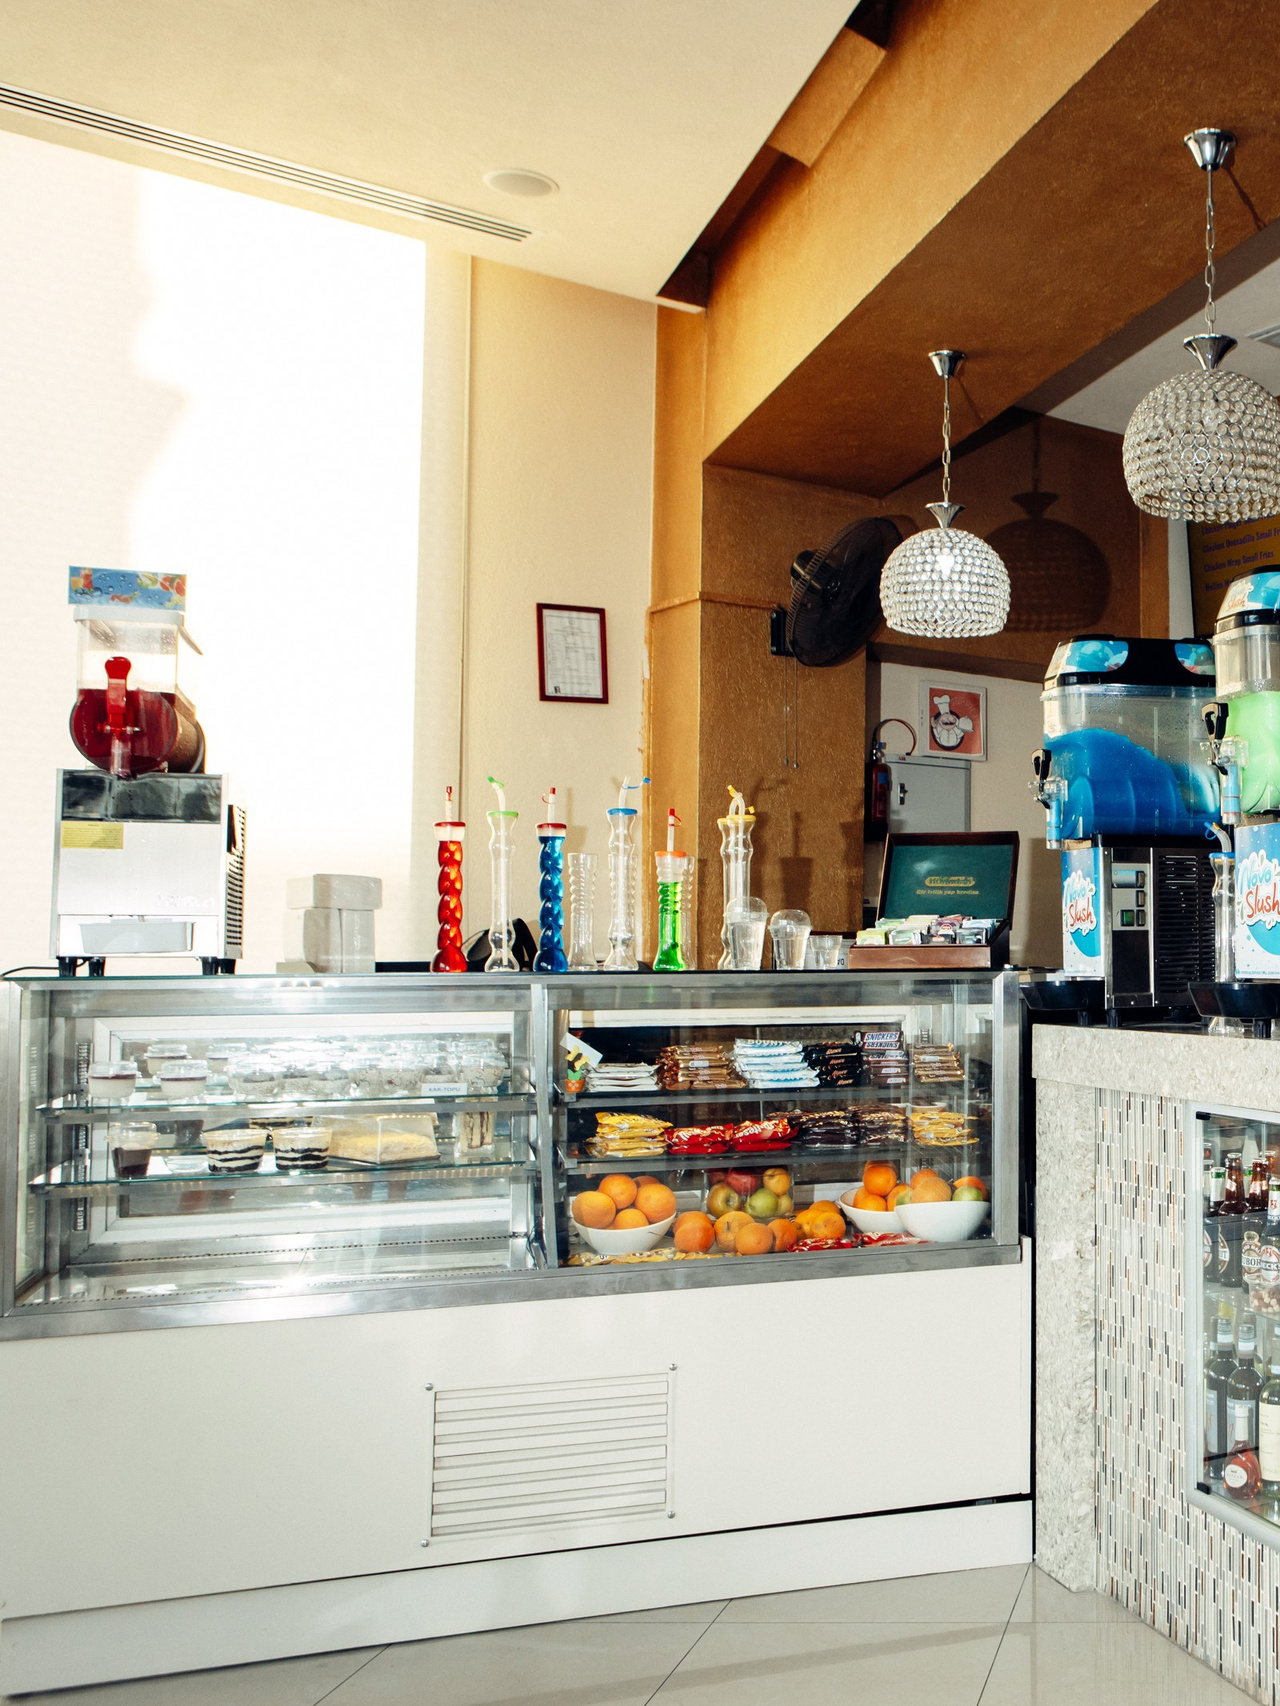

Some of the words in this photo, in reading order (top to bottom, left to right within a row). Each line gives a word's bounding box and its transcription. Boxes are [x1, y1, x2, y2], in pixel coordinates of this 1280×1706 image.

[1239, 864, 1272, 897] Novo
[1068, 897, 1094, 927] Slush
[865, 1031, 898, 1041] SNICKERS
